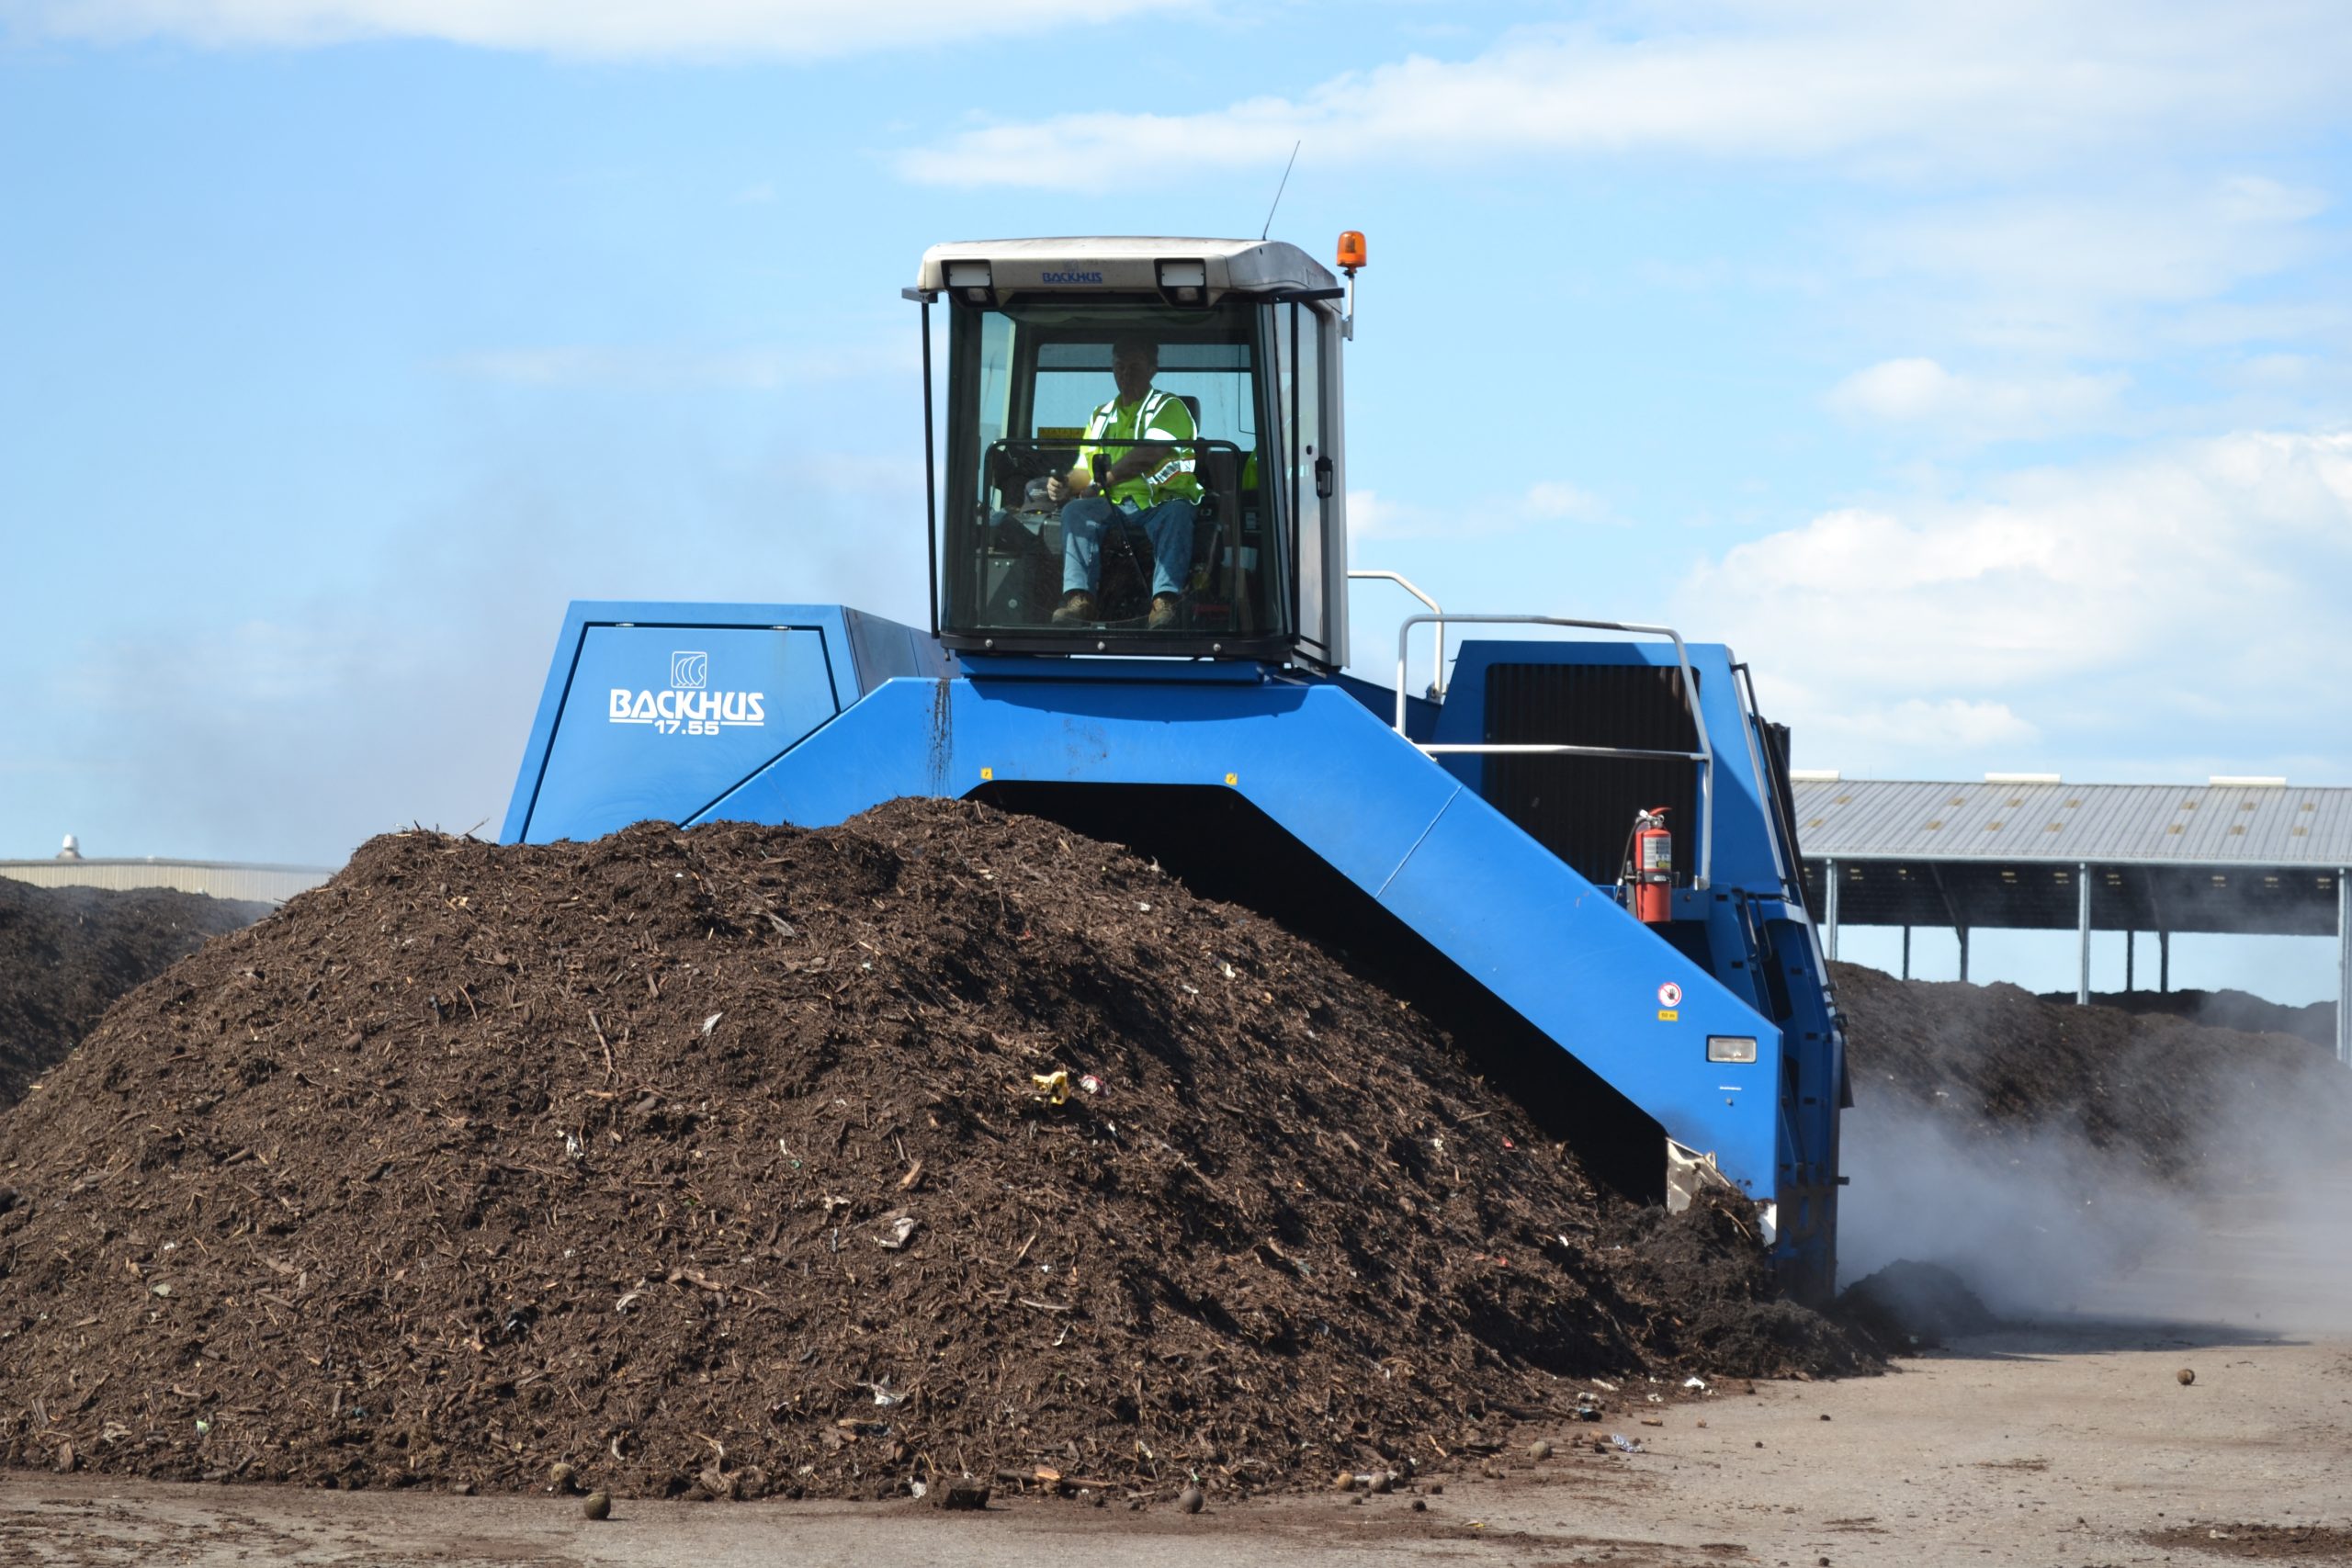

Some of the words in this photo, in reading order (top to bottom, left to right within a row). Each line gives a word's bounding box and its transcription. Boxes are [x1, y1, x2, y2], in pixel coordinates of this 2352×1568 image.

[1042, 272, 1102, 283] BACKHUS
[609, 689, 764, 721] BACKHUS
[653, 719, 719, 736] 17.55
